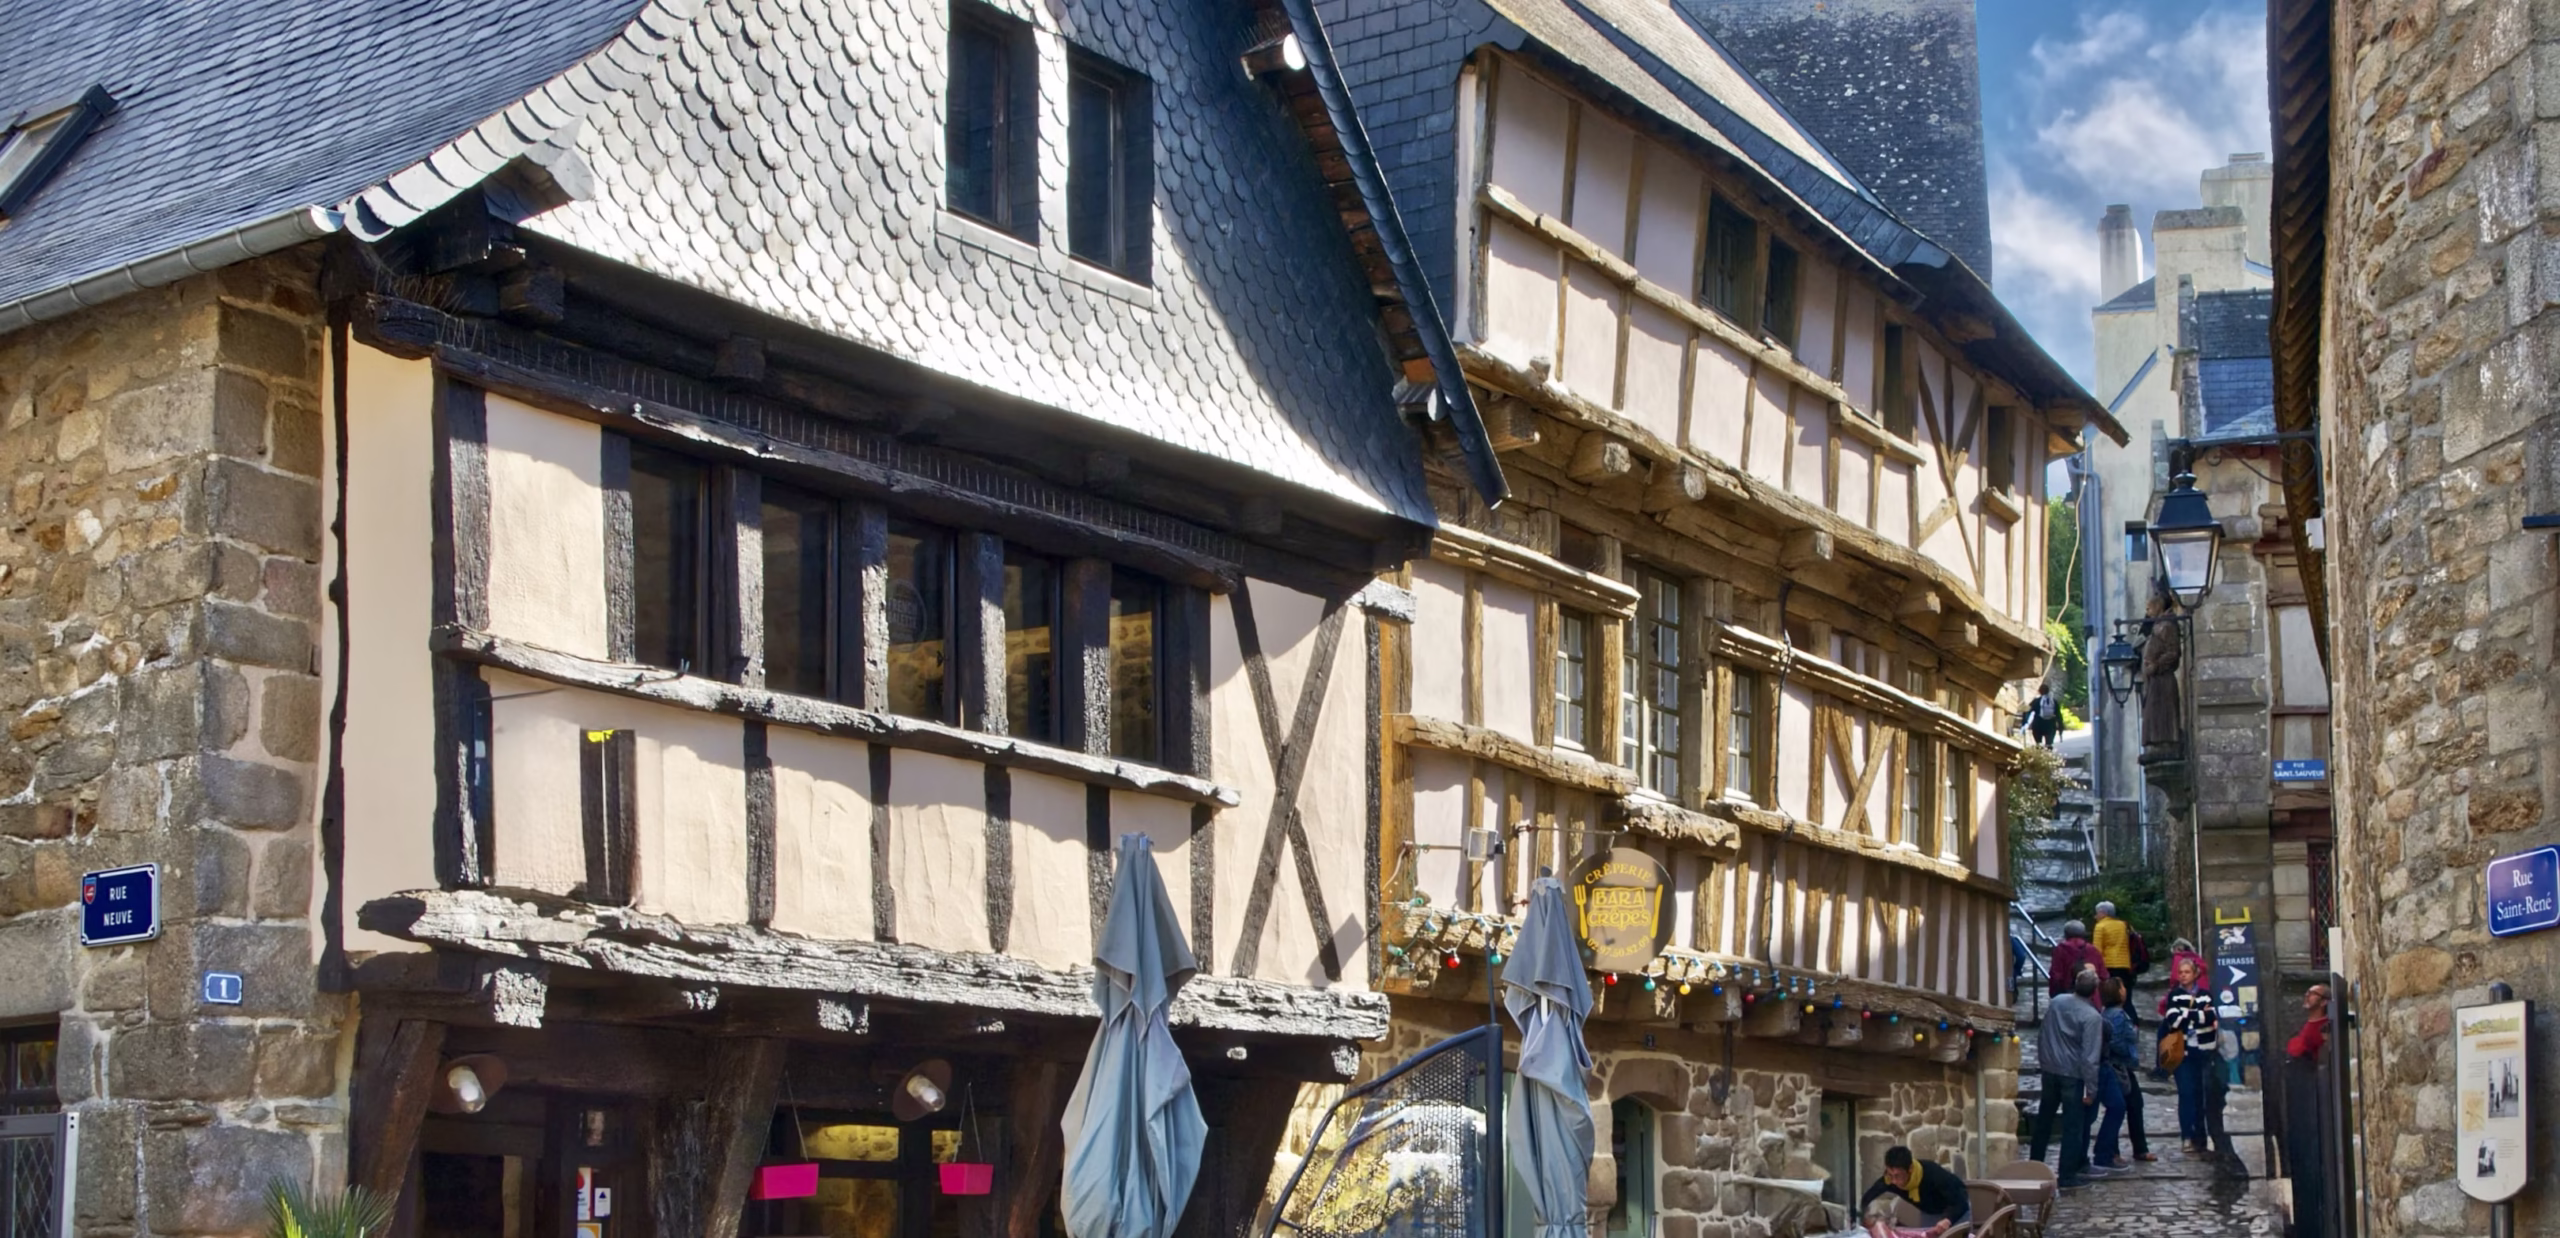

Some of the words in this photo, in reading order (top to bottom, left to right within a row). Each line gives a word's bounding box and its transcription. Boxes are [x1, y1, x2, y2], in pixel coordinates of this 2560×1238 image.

[1585, 862, 1652, 884] CRÊPERIE
[2512, 869, 2534, 888] Rue
[109, 885, 127, 901] RUE
[1595, 890, 1643, 905] BARA
[2496, 891, 2552, 921] Saint-René
[103, 909, 133, 927] NEUVE
[2217, 956, 2255, 966] TERRASSE
[220, 978, 228, 999] 1
